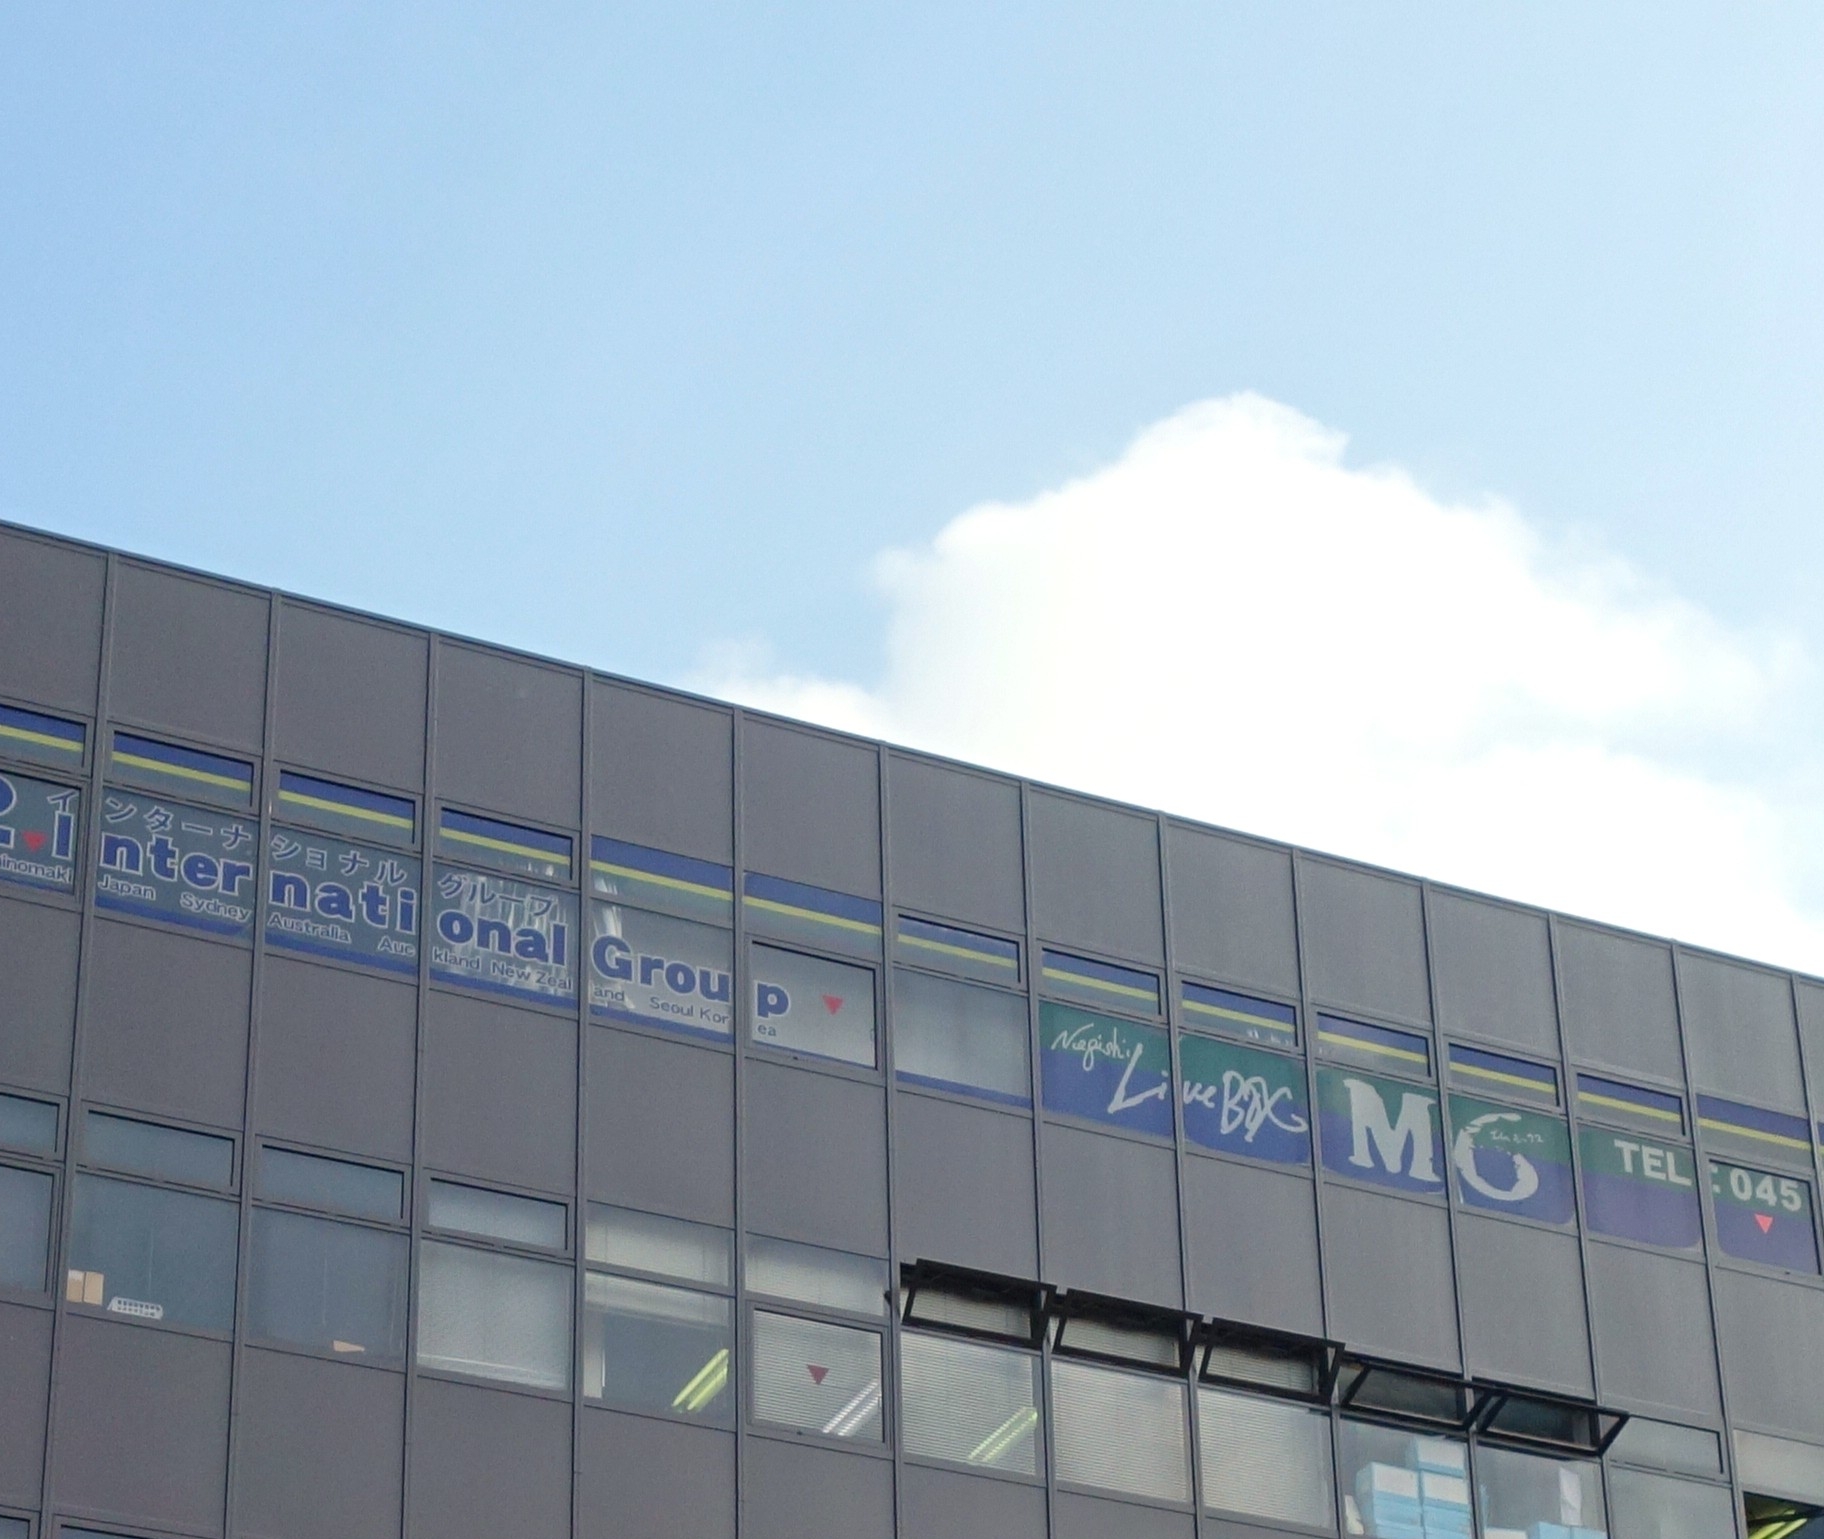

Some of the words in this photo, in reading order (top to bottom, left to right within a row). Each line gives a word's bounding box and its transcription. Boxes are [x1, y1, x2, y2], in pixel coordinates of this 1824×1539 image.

[52, 808, 568, 967] International
[590, 934, 791, 1020] Group
[97, 873, 157, 901] Japan
[179, 891, 252, 923] Sydney
[267, 912, 352, 944] Australia
[378, 934, 481, 972] Auckland
[491, 959, 532, 982] New
[535, 968, 626, 1004] Zealand
[649, 995, 695, 1018] Seoul
[699, 1007, 777, 1038] Korea
